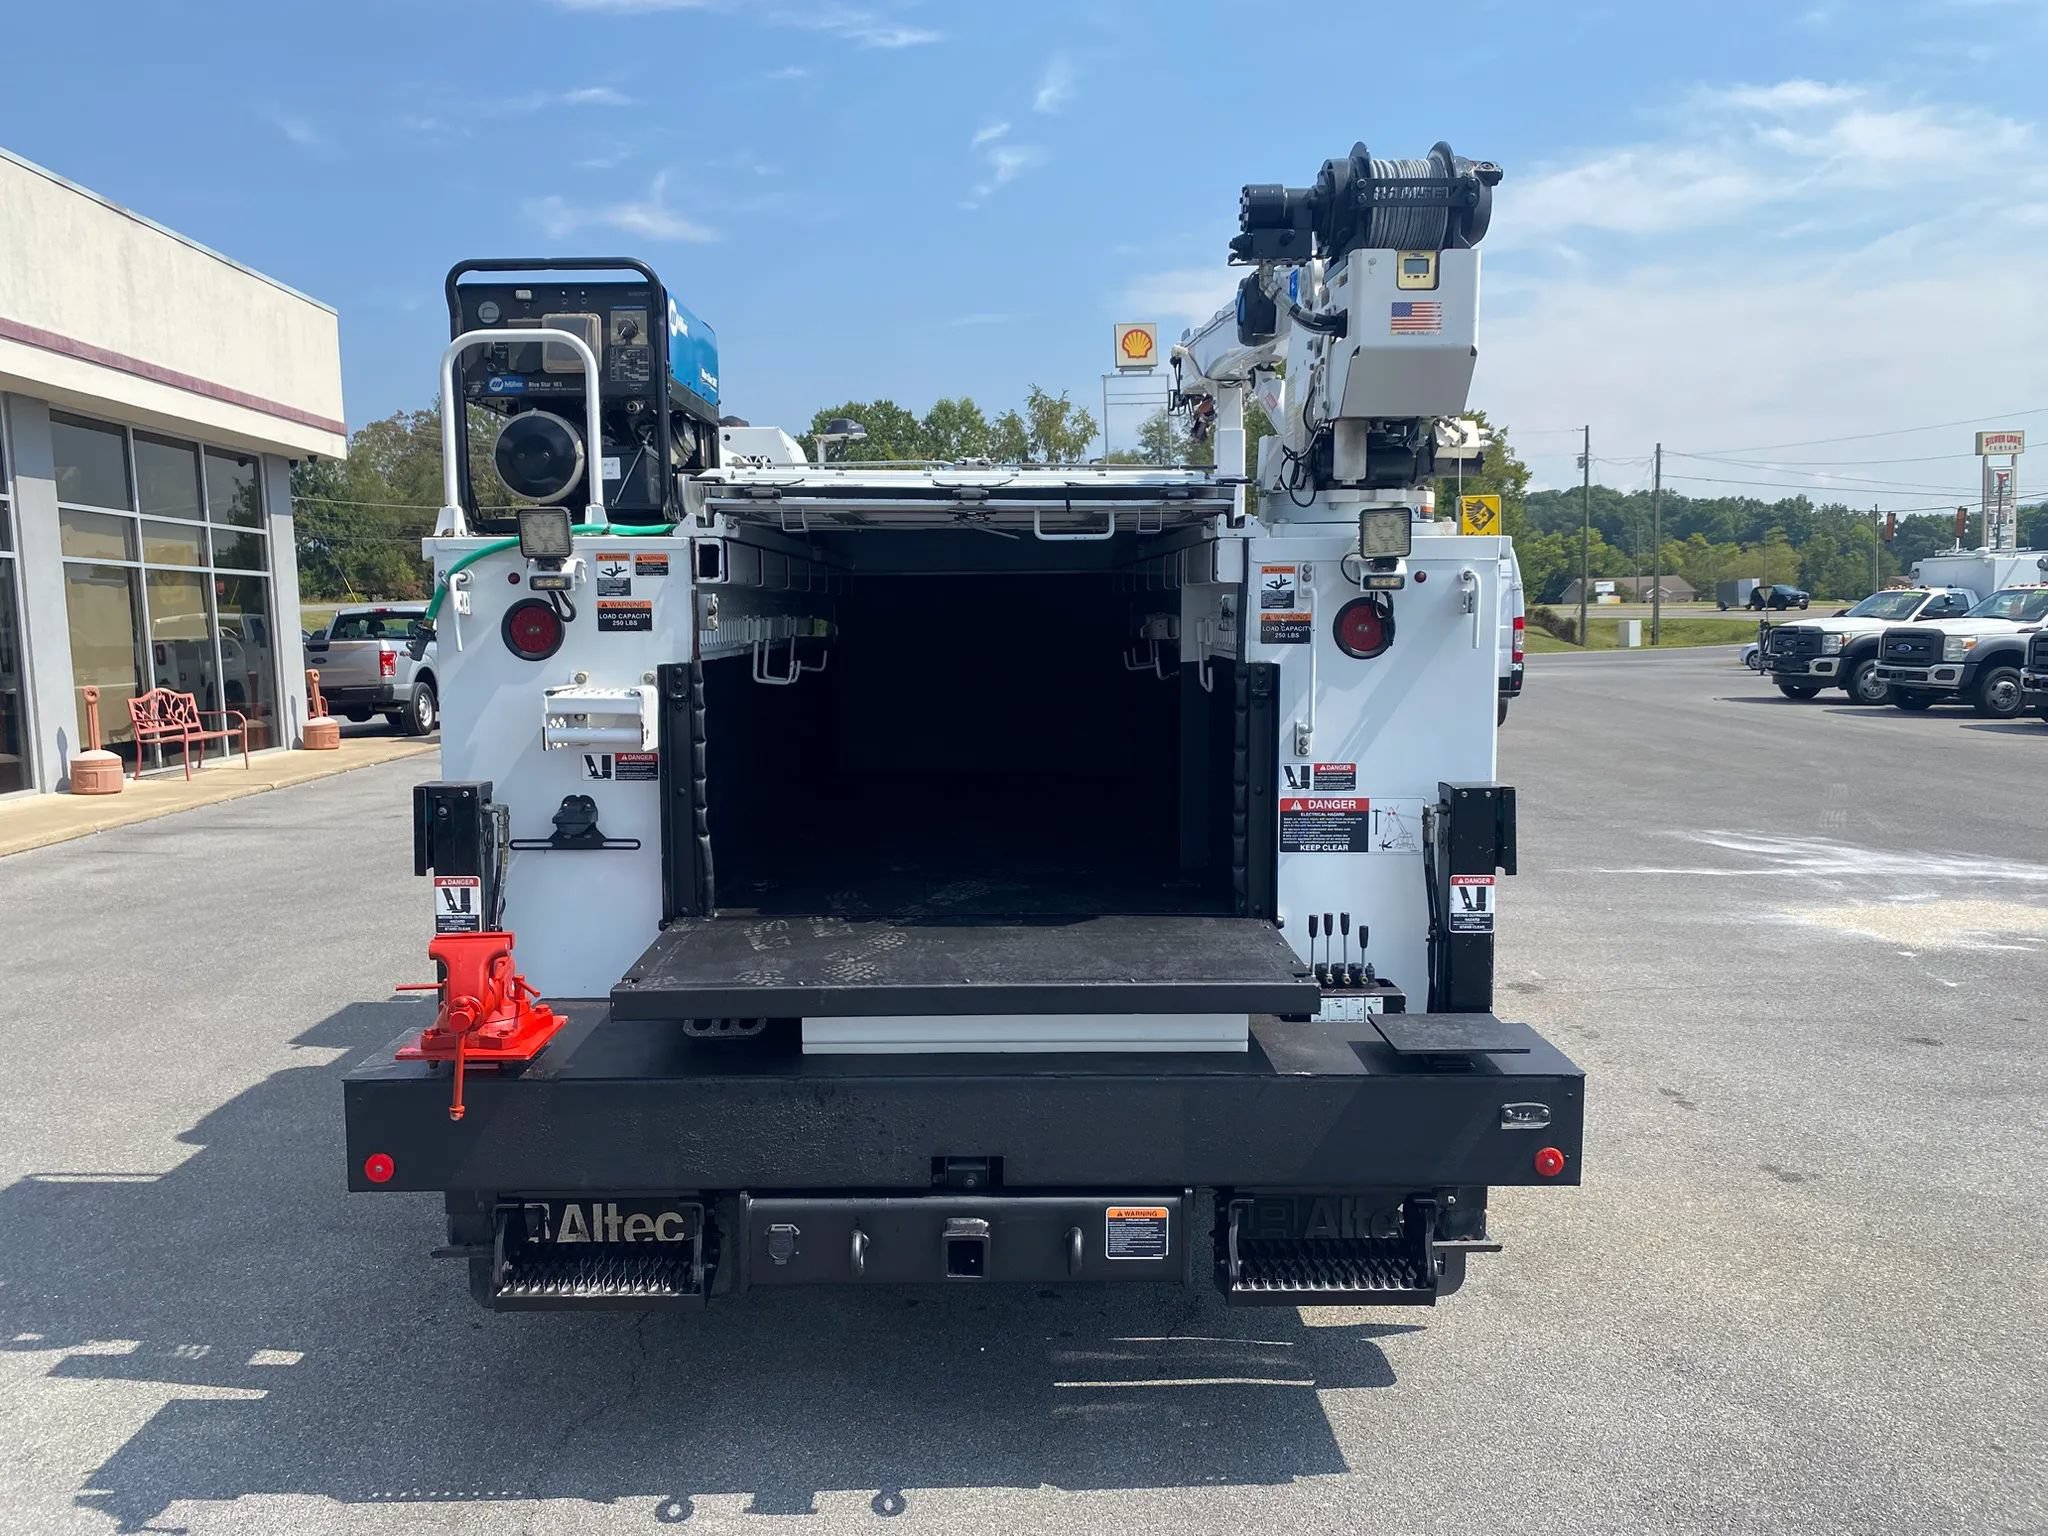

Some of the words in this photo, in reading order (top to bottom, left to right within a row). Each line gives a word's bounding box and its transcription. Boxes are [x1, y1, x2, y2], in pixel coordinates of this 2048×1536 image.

[1308, 800, 1357, 809] DANGER
[556, 1202, 685, 1243] Altec
[1303, 1196, 1406, 1239] Alte
